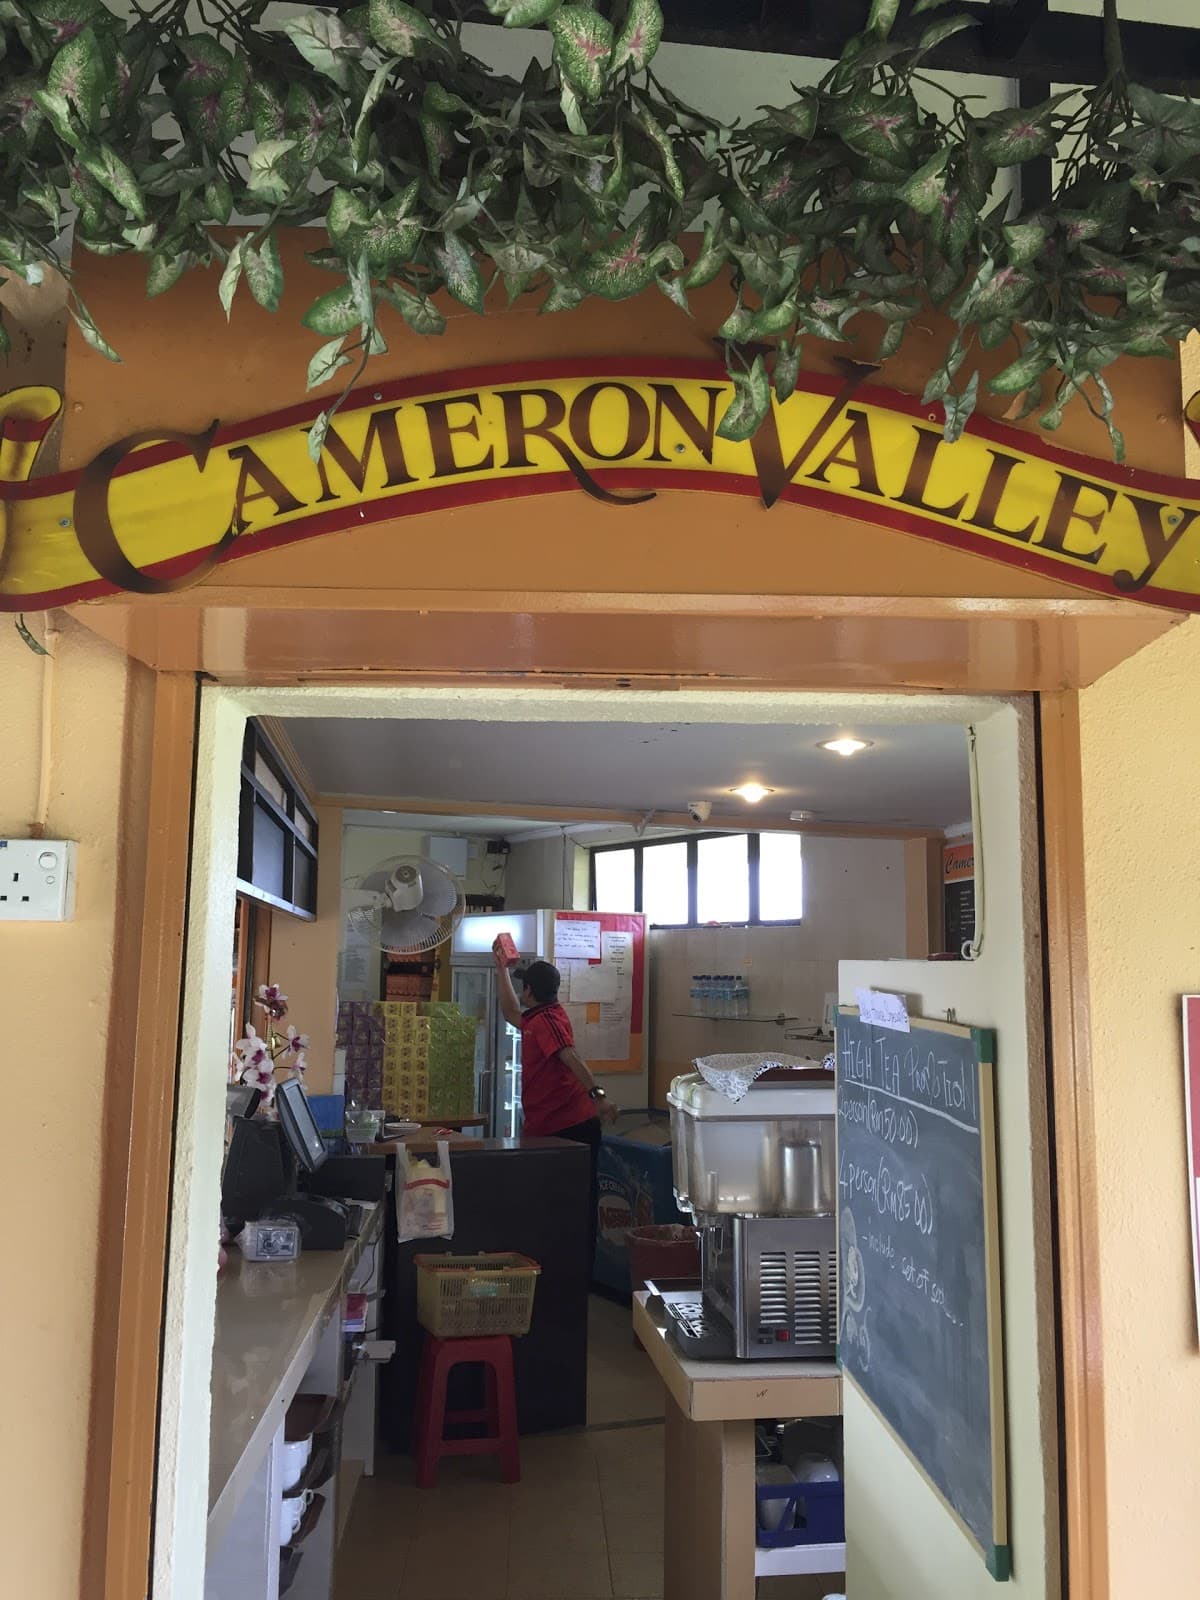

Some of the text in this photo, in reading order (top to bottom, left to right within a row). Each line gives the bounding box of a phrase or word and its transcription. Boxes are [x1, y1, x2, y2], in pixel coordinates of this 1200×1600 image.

[73, 337, 1200, 593] CAMERON VALLEY
[842, 1028, 873, 1092] HIGH
[875, 1037, 900, 1097] TEA
